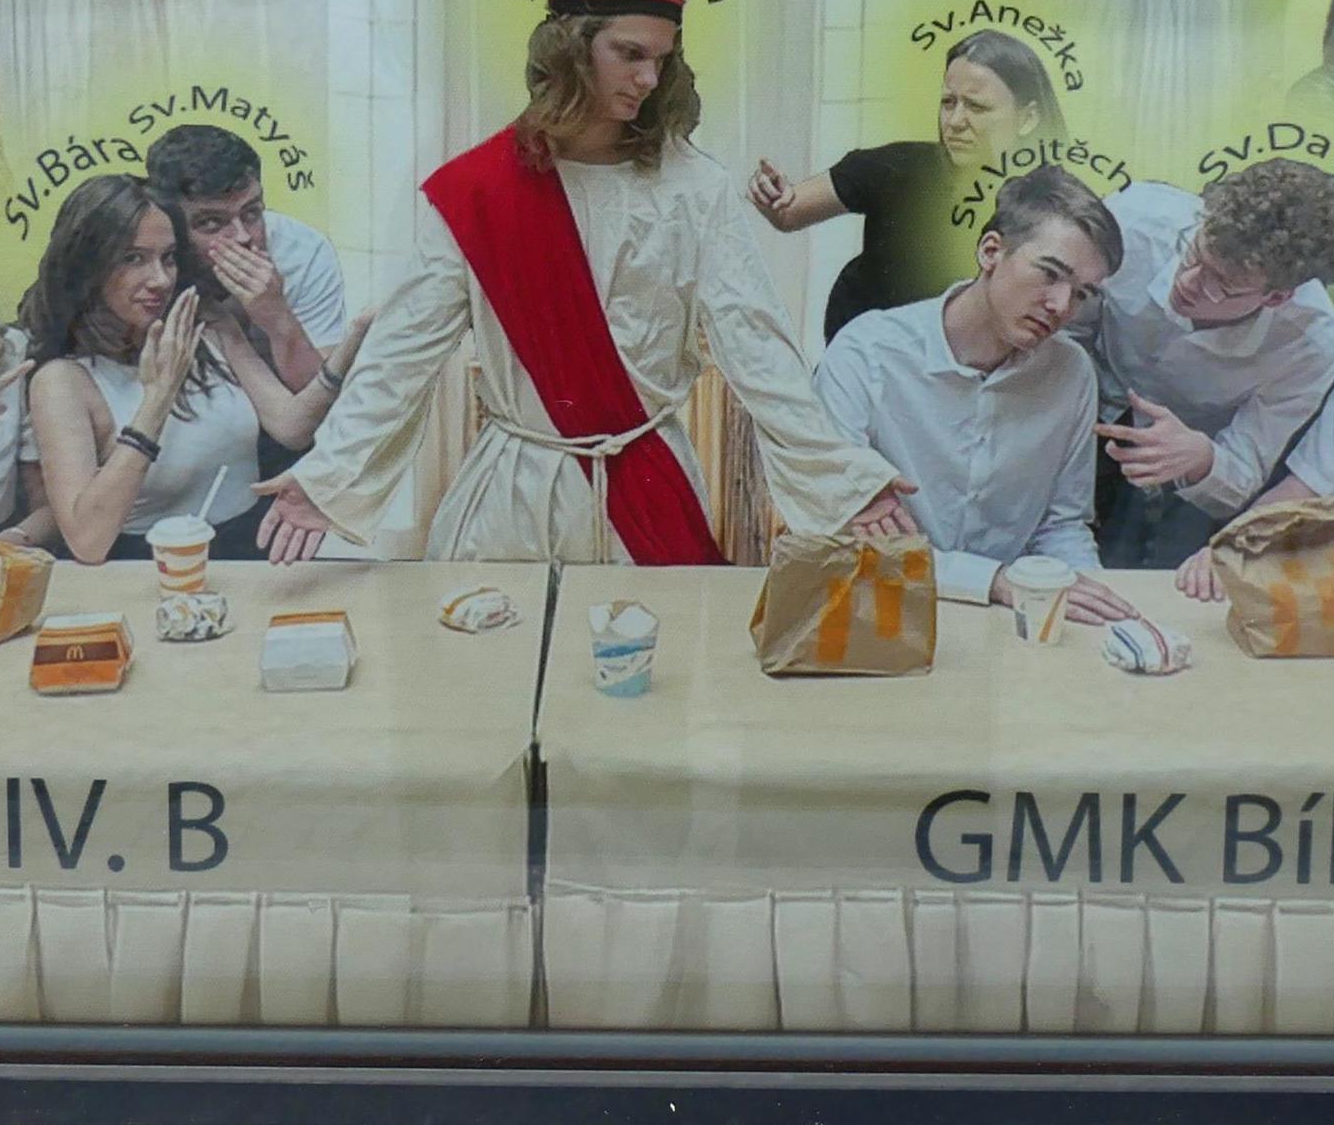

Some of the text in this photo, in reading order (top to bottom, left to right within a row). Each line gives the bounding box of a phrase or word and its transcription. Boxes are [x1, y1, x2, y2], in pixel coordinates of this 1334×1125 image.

[911, 0, 1084, 93] Sv.Anežka
[5, 131, 144, 241] Sv.Bára
[128, 85, 315, 193] Sv.Matyáš
[6, 777, 126, 873] IV.
[167, 780, 231, 873] B
[913, 788, 1187, 887] GMK
